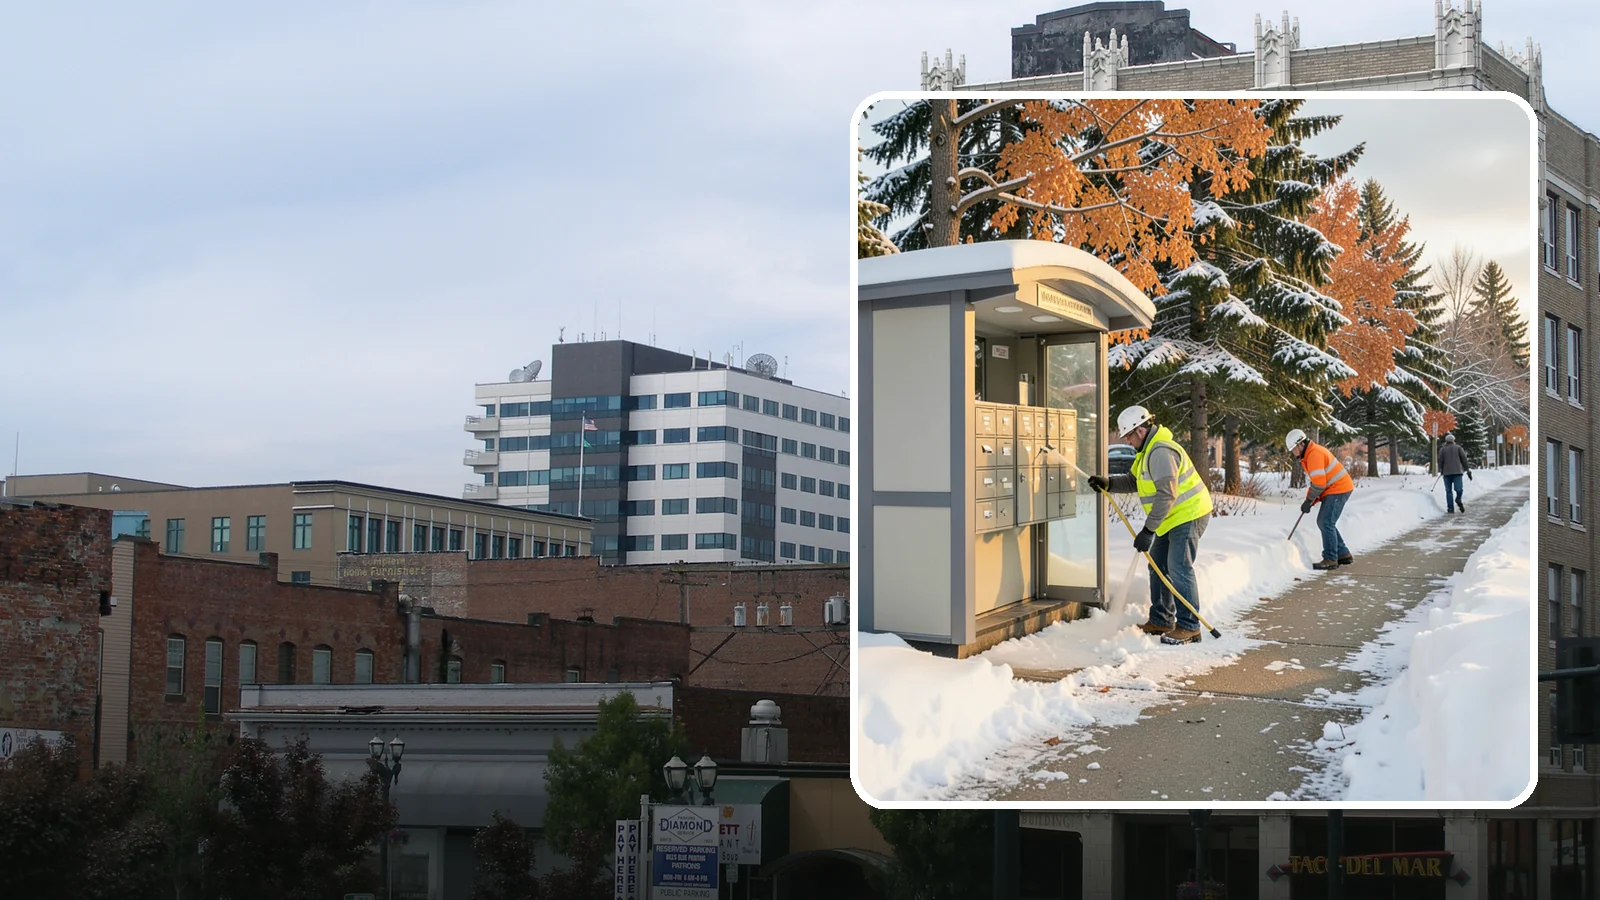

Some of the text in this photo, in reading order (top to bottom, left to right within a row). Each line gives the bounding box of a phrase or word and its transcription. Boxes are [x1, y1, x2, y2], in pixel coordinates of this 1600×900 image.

[370, 566, 427, 576] Furnishers
[1022, 815, 1070, 827] BUILDING
[617, 825, 625, 852] PAY
[629, 824, 637, 852] PAY
[656, 845, 716, 854] RESERVED PARKING
[671, 862, 701, 870] PATRONS
[1346, 856, 1385, 875] DEL
[1392, 857, 1443, 876] MAR
[617, 856, 625, 893] HERE
[628, 856, 636, 893] HERE
[660, 888, 710, 898] PUBLIC PARKING
